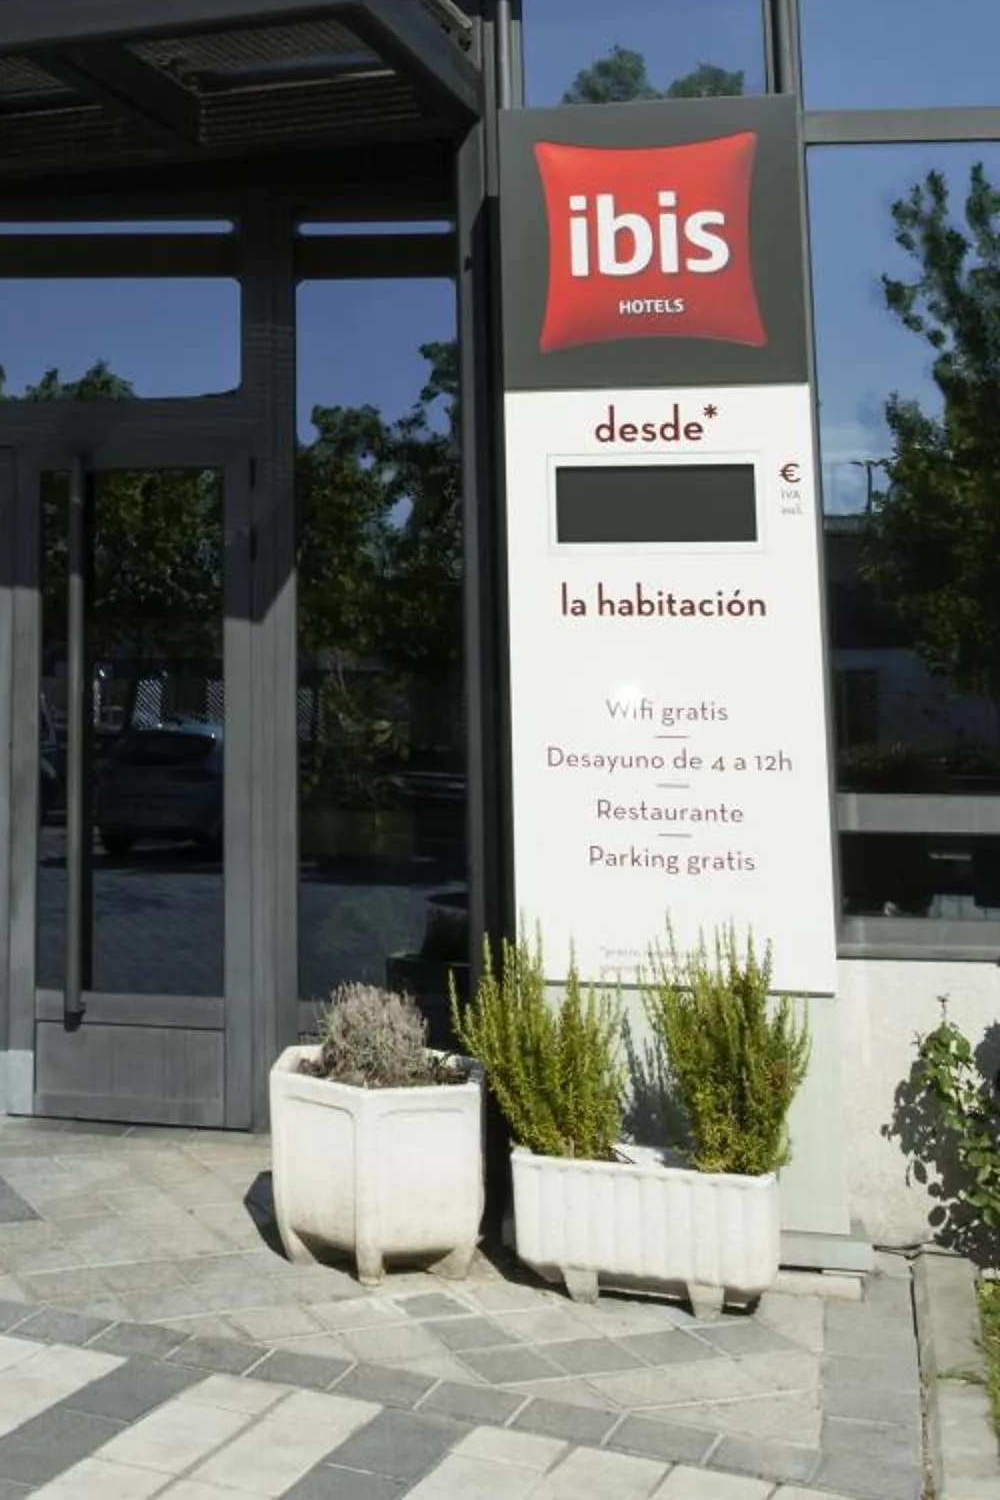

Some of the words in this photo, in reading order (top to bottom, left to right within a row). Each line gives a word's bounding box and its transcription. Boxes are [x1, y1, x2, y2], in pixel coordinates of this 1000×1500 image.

[569, 191, 730, 277] ibis
[619, 298, 685, 315] HOTELS
[561, 582, 586, 617] la
[598, 582, 767, 617] habitación
[606, 699, 654, 721] Wifi
[661, 701, 729, 726] gratis
[547, 747, 665, 773] Desayuno
[673, 748, 703, 769] de
[711, 756, 726, 772] 4
[734, 757, 747, 771] a
[755, 750, 793, 772] 12h
[597, 799, 744, 823] Restaurante
[588, 845, 680, 874] Parking
[687, 850, 756, 874] gratis
